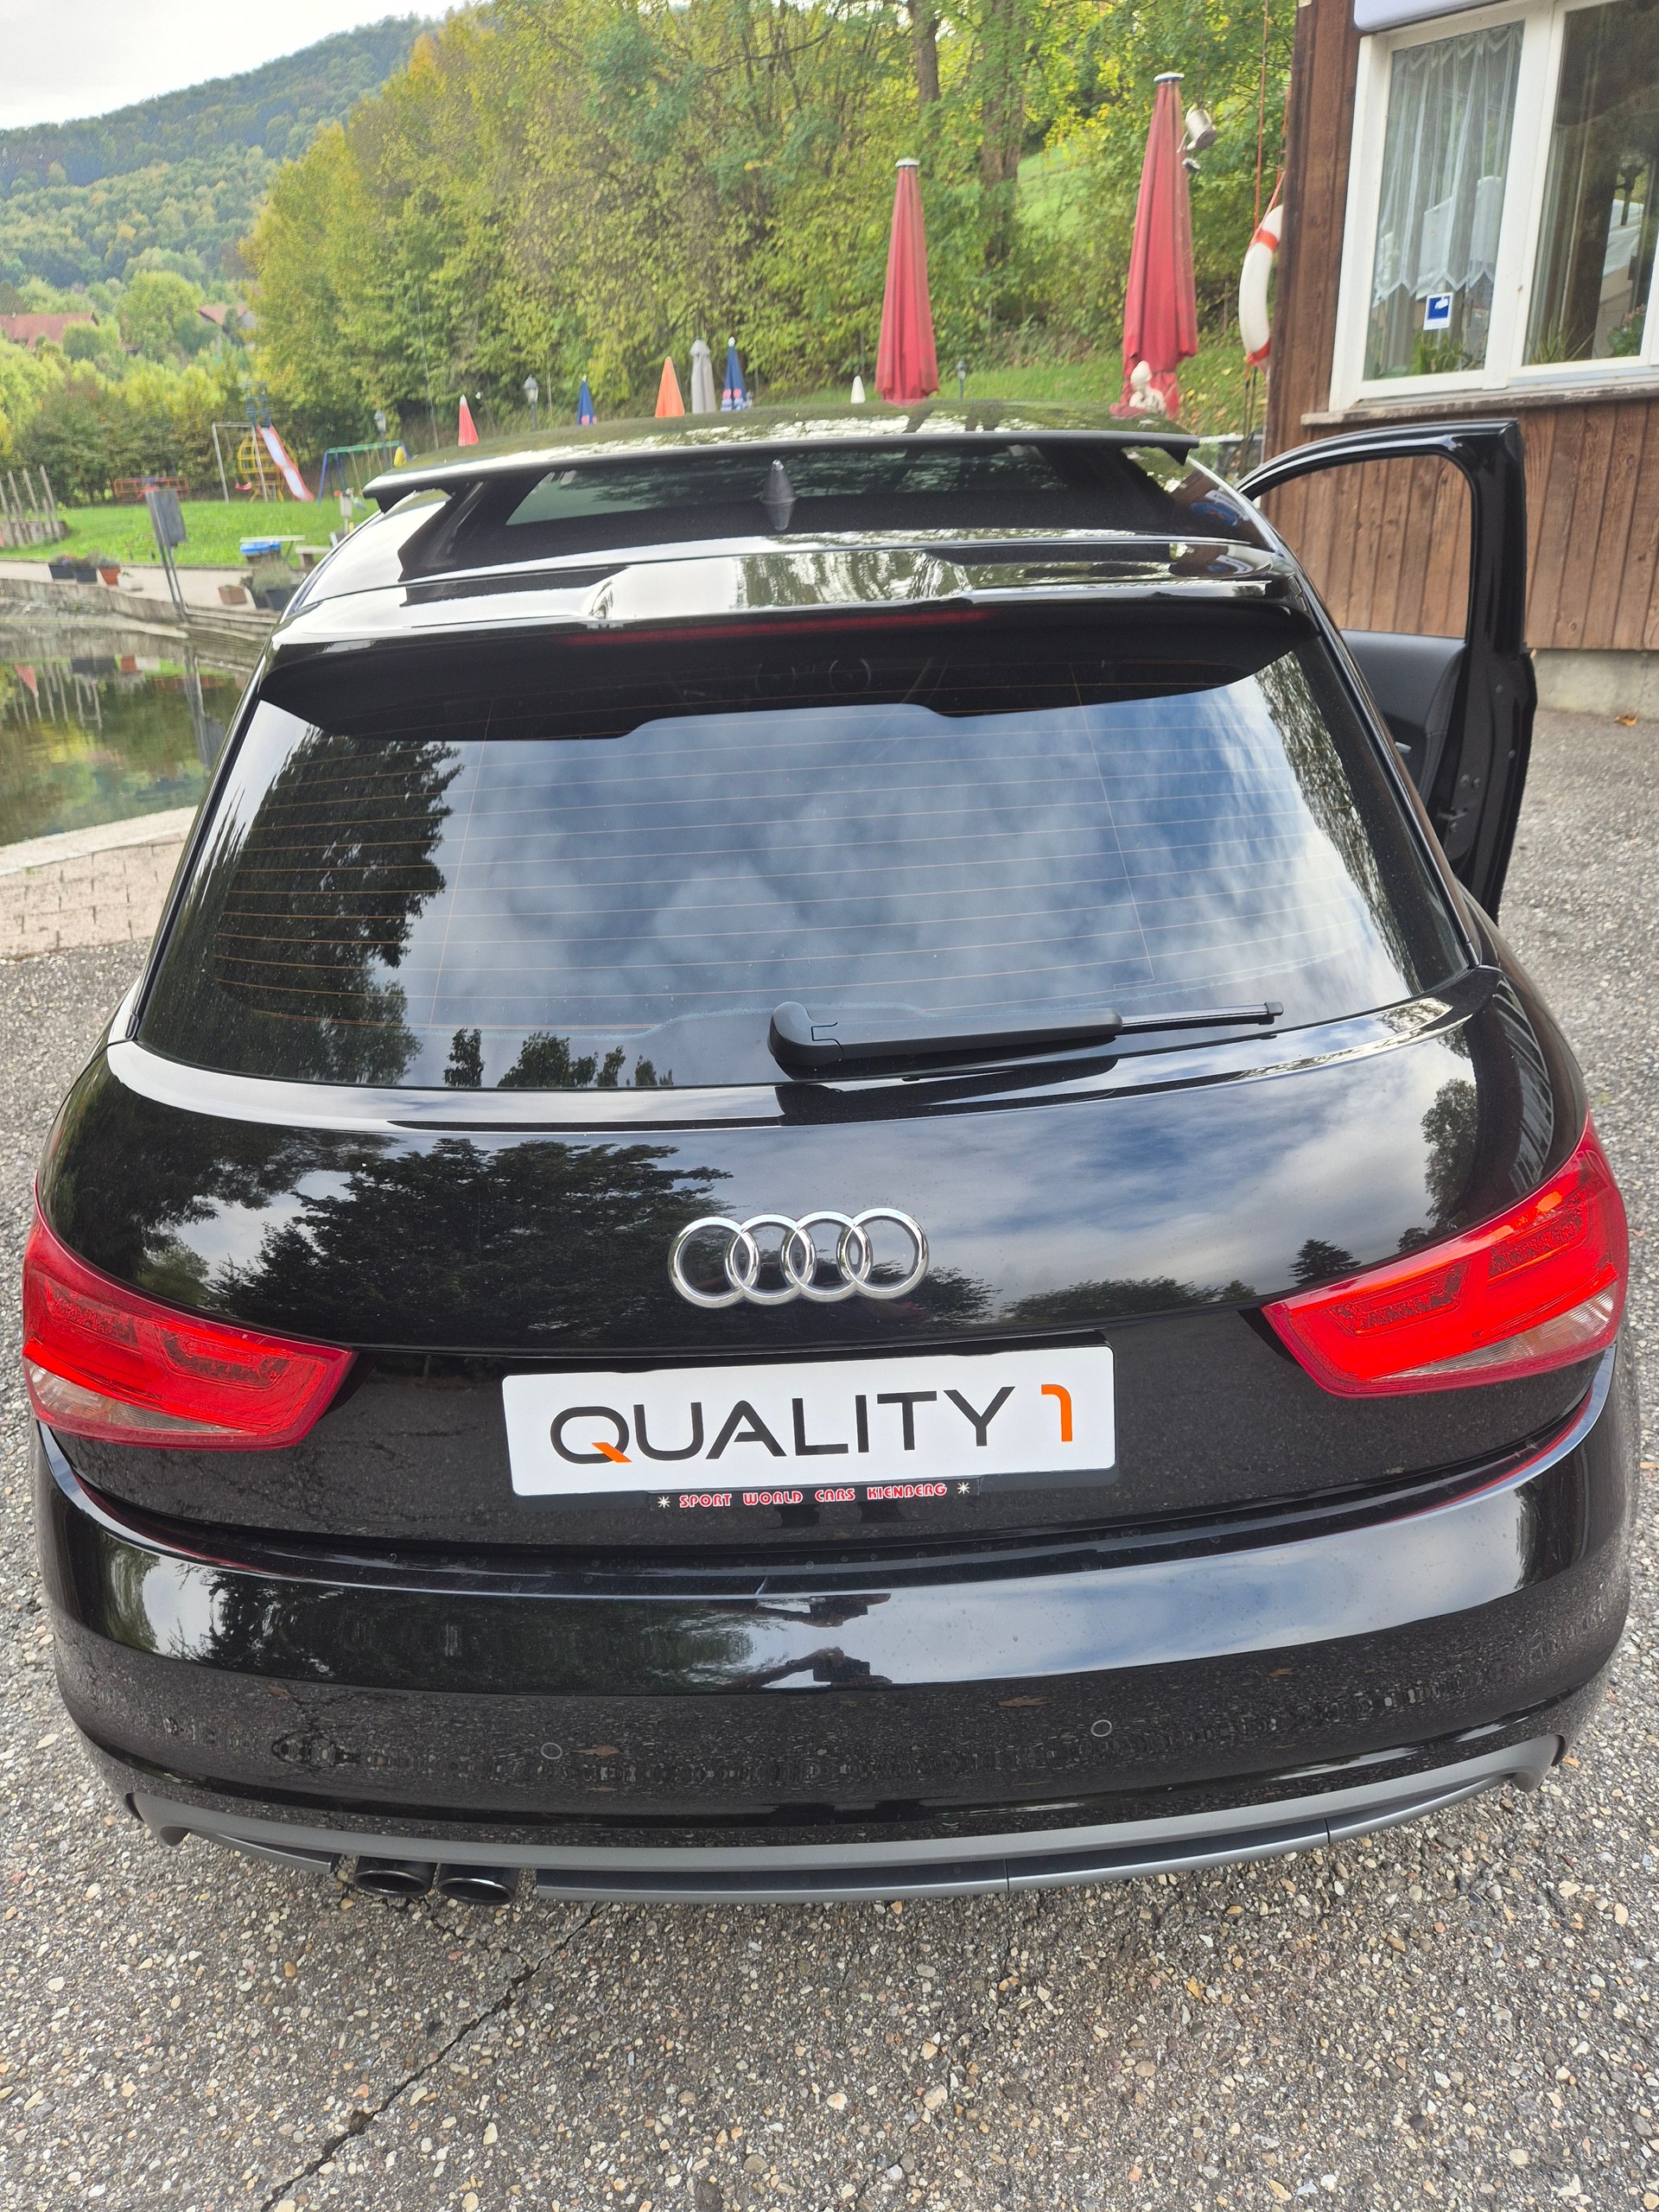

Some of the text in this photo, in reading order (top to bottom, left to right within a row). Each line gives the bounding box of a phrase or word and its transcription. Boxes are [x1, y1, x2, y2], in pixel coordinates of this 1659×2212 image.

[550, 1383, 1073, 1465] QUALITY 1
[679, 1483, 947, 1509] SPORT WORLD CARS KIENBERG
